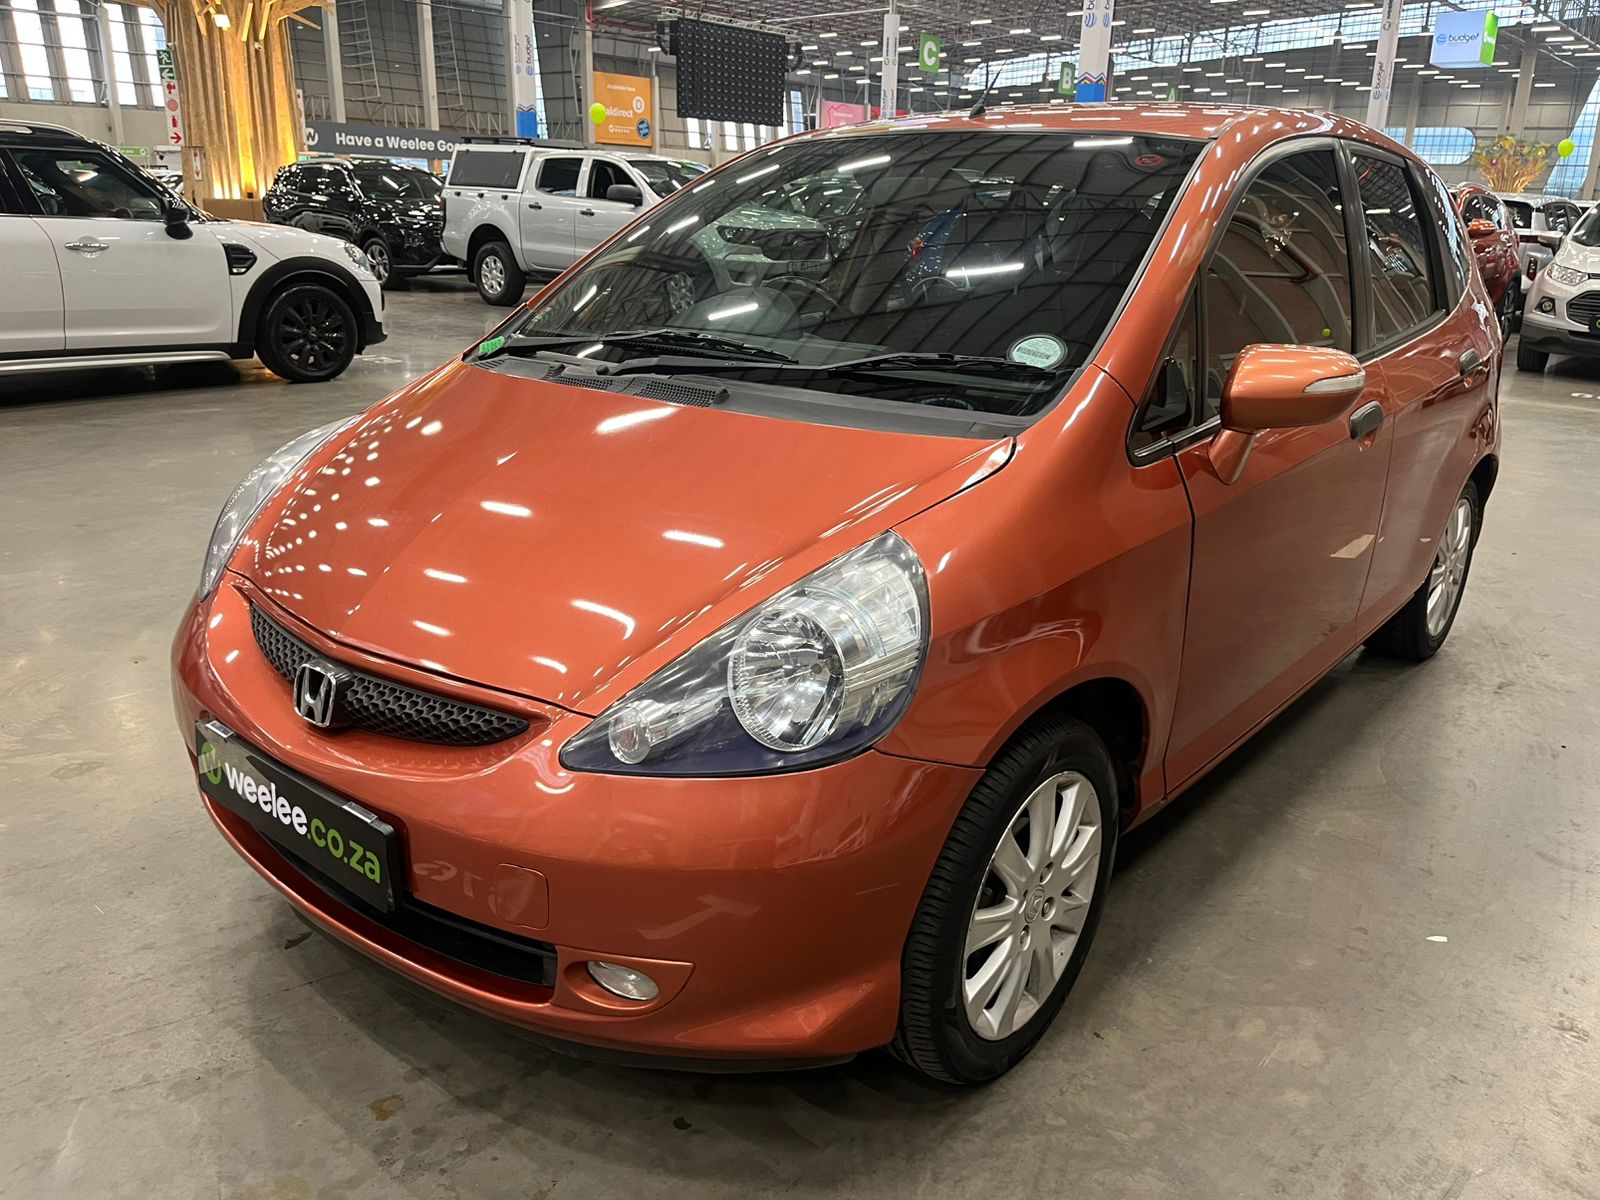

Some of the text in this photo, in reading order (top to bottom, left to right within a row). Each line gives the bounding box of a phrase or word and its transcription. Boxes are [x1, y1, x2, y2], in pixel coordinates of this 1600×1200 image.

[1448, 32, 1480, 45] budget
[923, 40, 937, 66] C
[1062, 67, 1072, 89] B
[604, 107, 633, 119] aldirect
[335, 132, 373, 147] Have
[374, 137, 384, 148] a
[386, 136, 435, 151] Weelee
[225, 761, 380, 884] weelee.co.za
